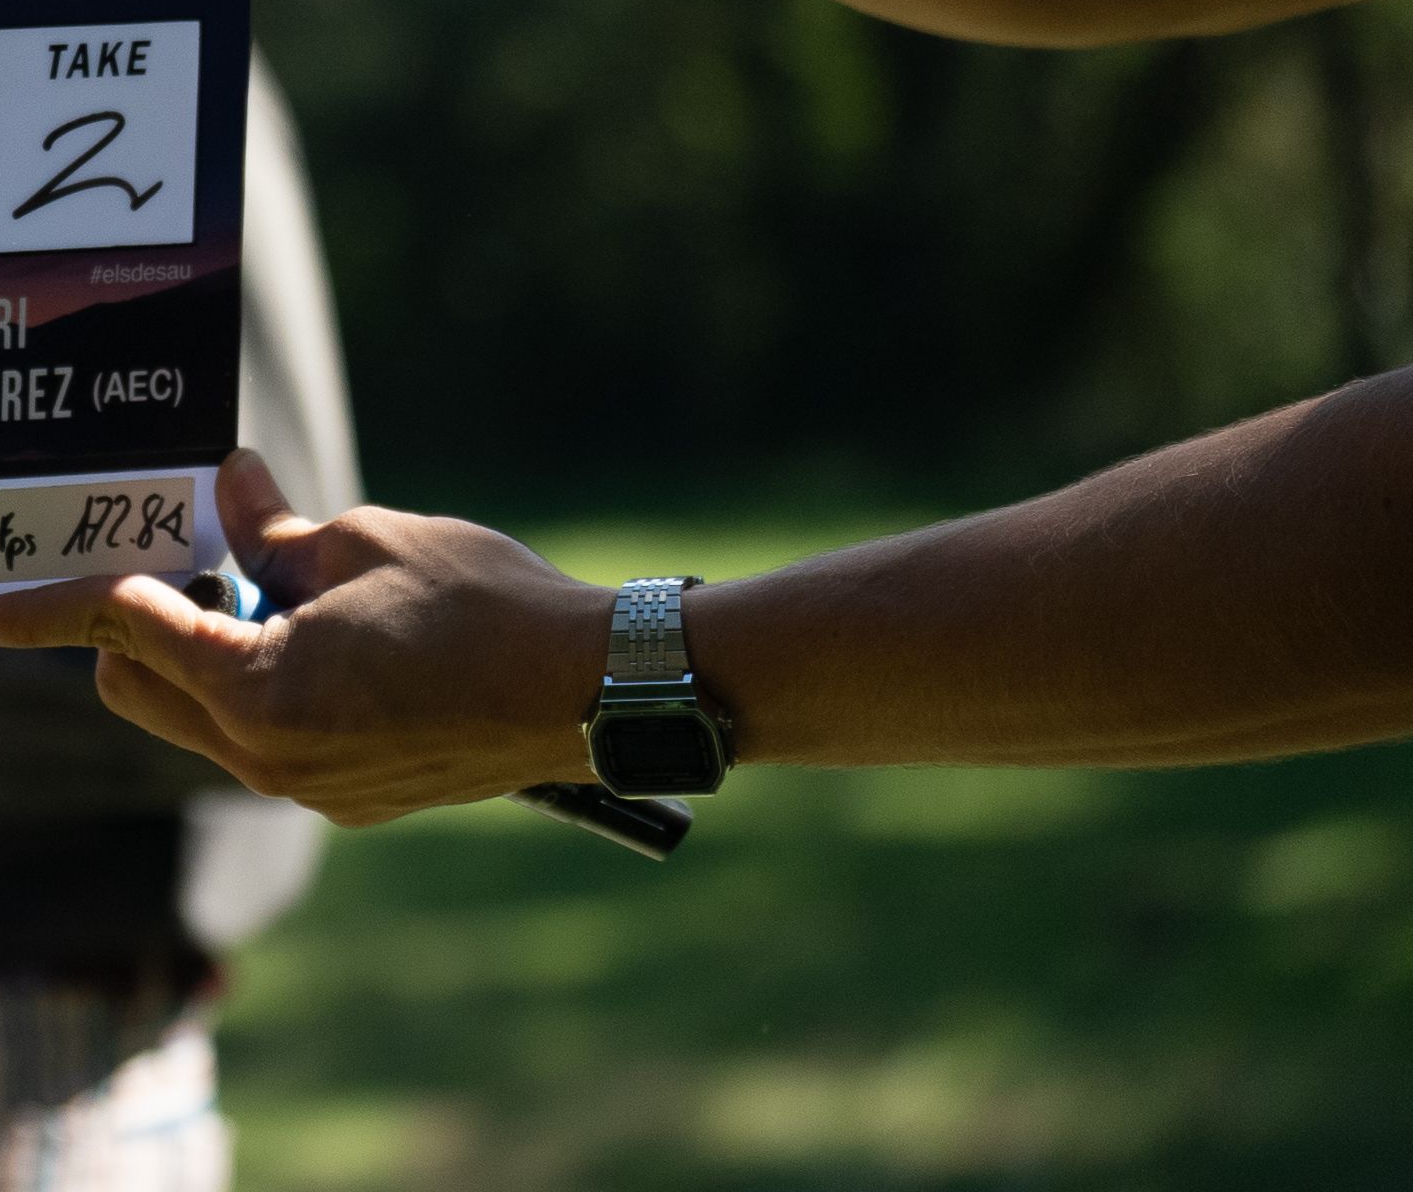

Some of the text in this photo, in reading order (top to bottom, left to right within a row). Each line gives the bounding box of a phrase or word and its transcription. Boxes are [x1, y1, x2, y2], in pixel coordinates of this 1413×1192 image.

[47, 40, 152, 81] TAKE
[12, 111, 164, 220] 2
[89, 263, 192, 285] #elsdesau
[92, 367, 185, 413] (AEC)
